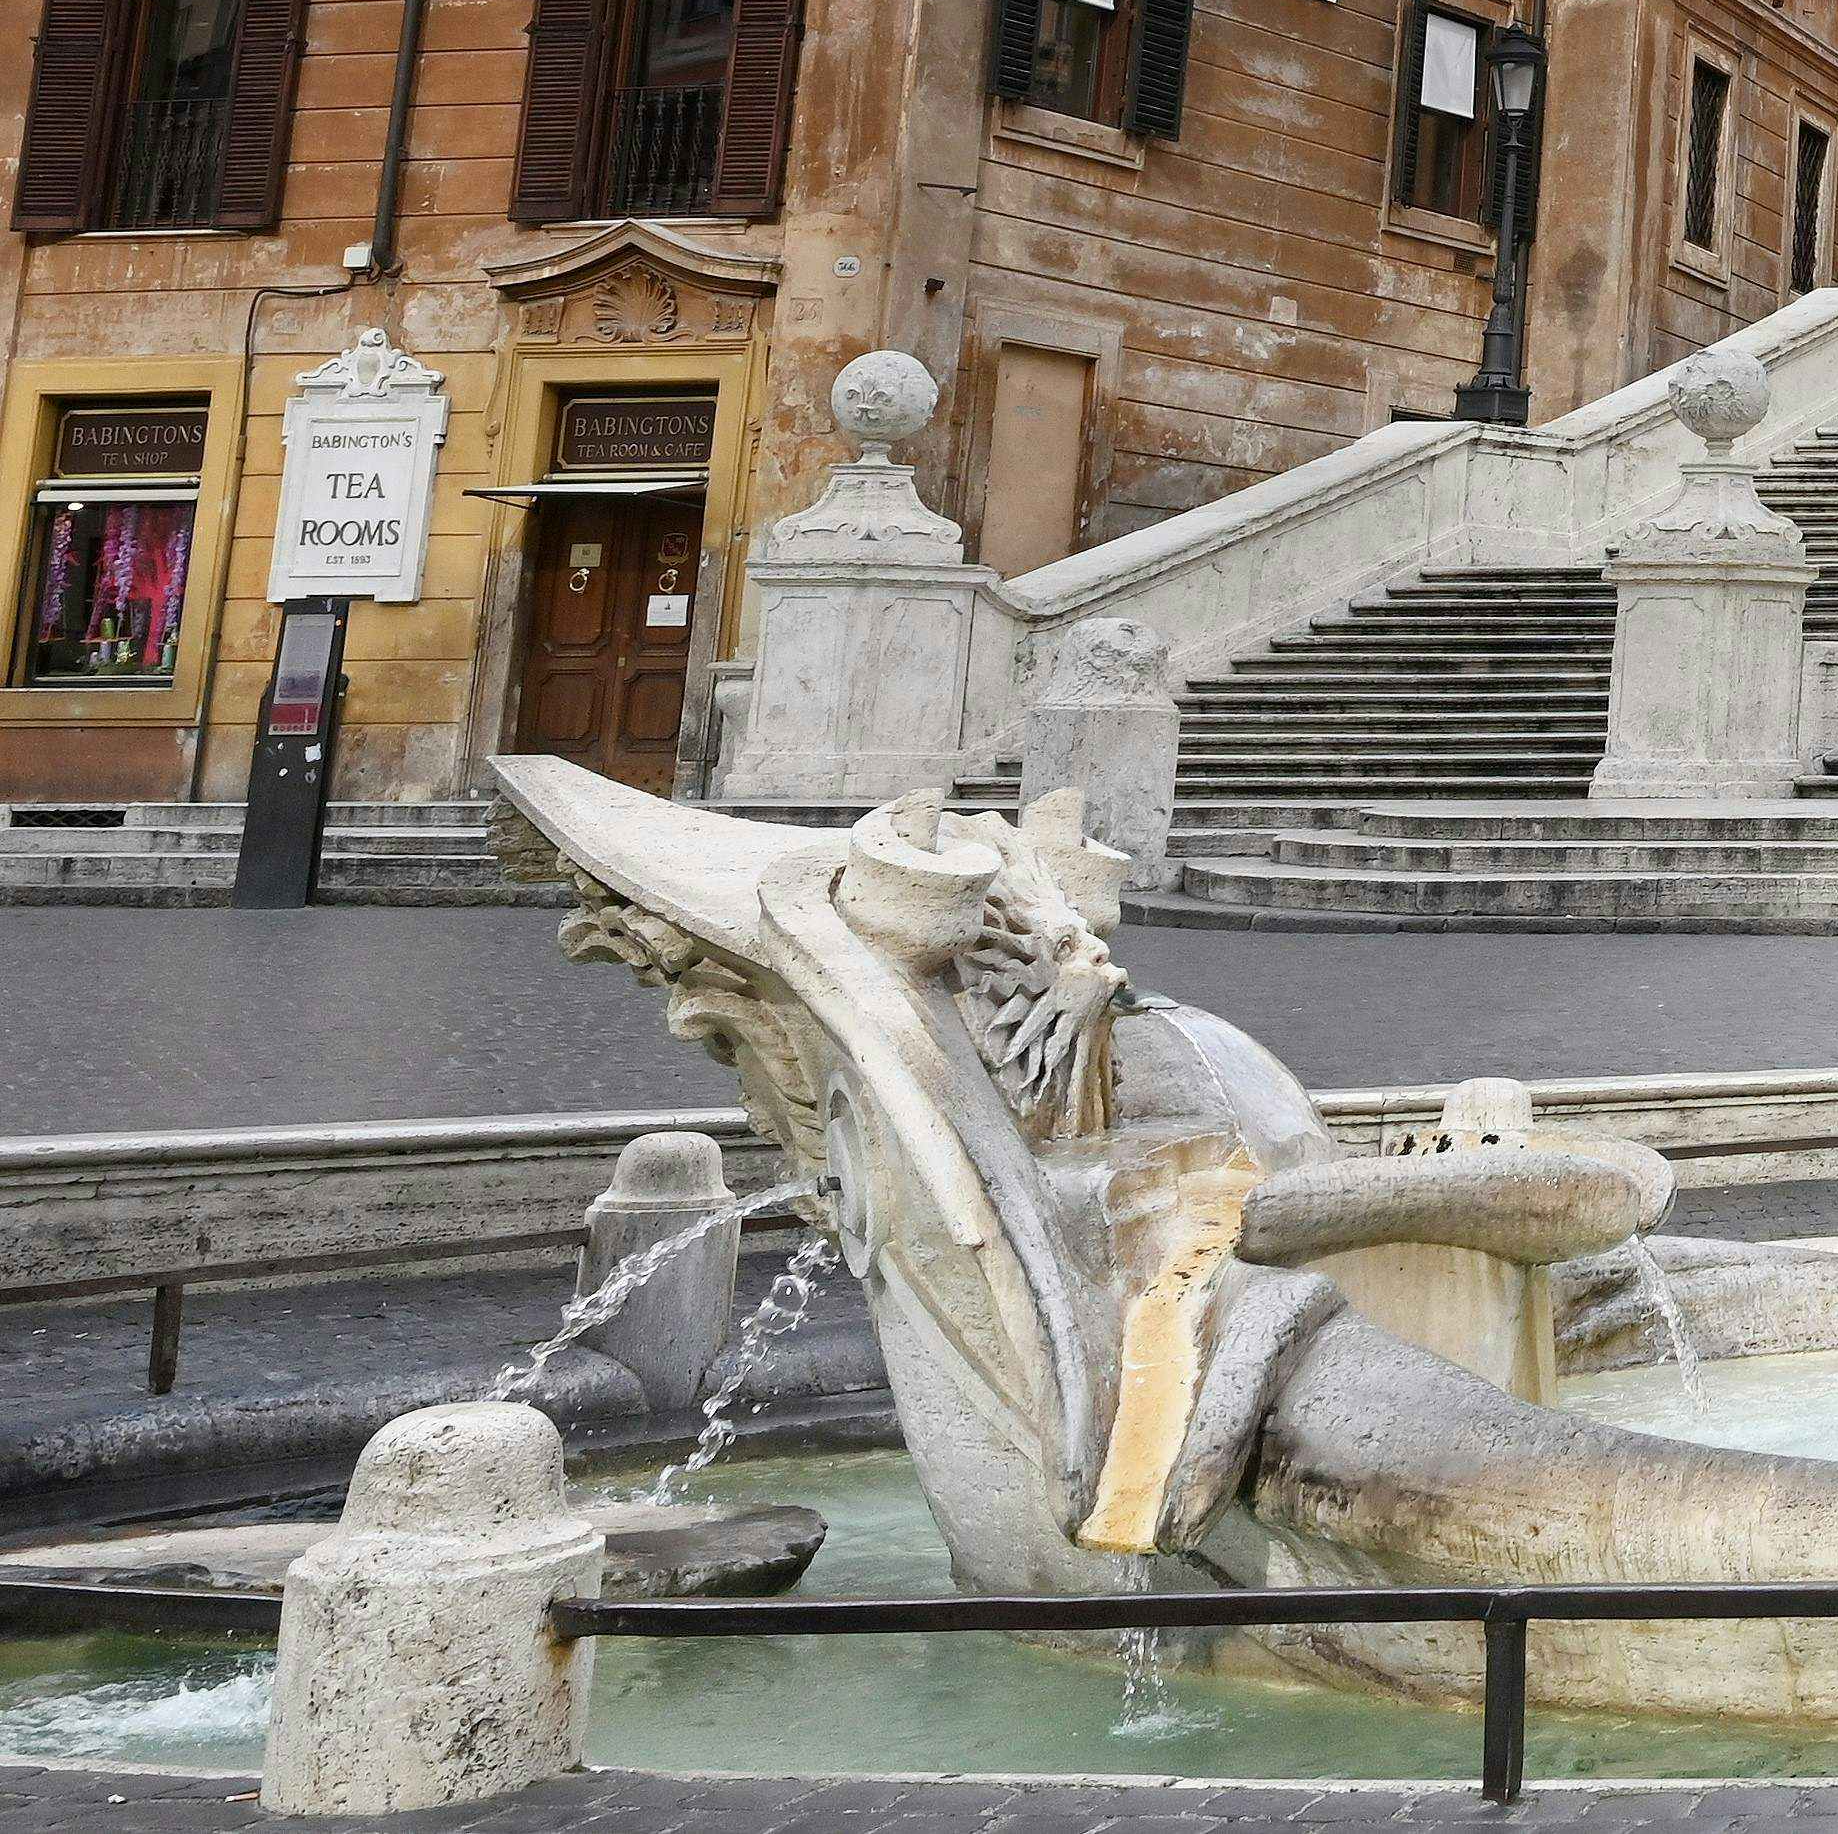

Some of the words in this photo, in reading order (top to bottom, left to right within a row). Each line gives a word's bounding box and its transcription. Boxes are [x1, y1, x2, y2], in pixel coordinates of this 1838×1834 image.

[71, 424, 206, 447] BABINGTONS
[573, 415, 710, 438] BABINGTONS
[311, 433, 414, 450] BABINGTON'S
[577, 444, 606, 458] TEA
[609, 443, 648, 458] ROOM
[650, 445, 662, 457] &
[101, 451, 129, 468] TEA
[132, 450, 170, 466] SHOP
[326, 472, 386, 500] TEA
[299, 519, 402, 547] ROOMS
[325, 555, 344, 565] EST
